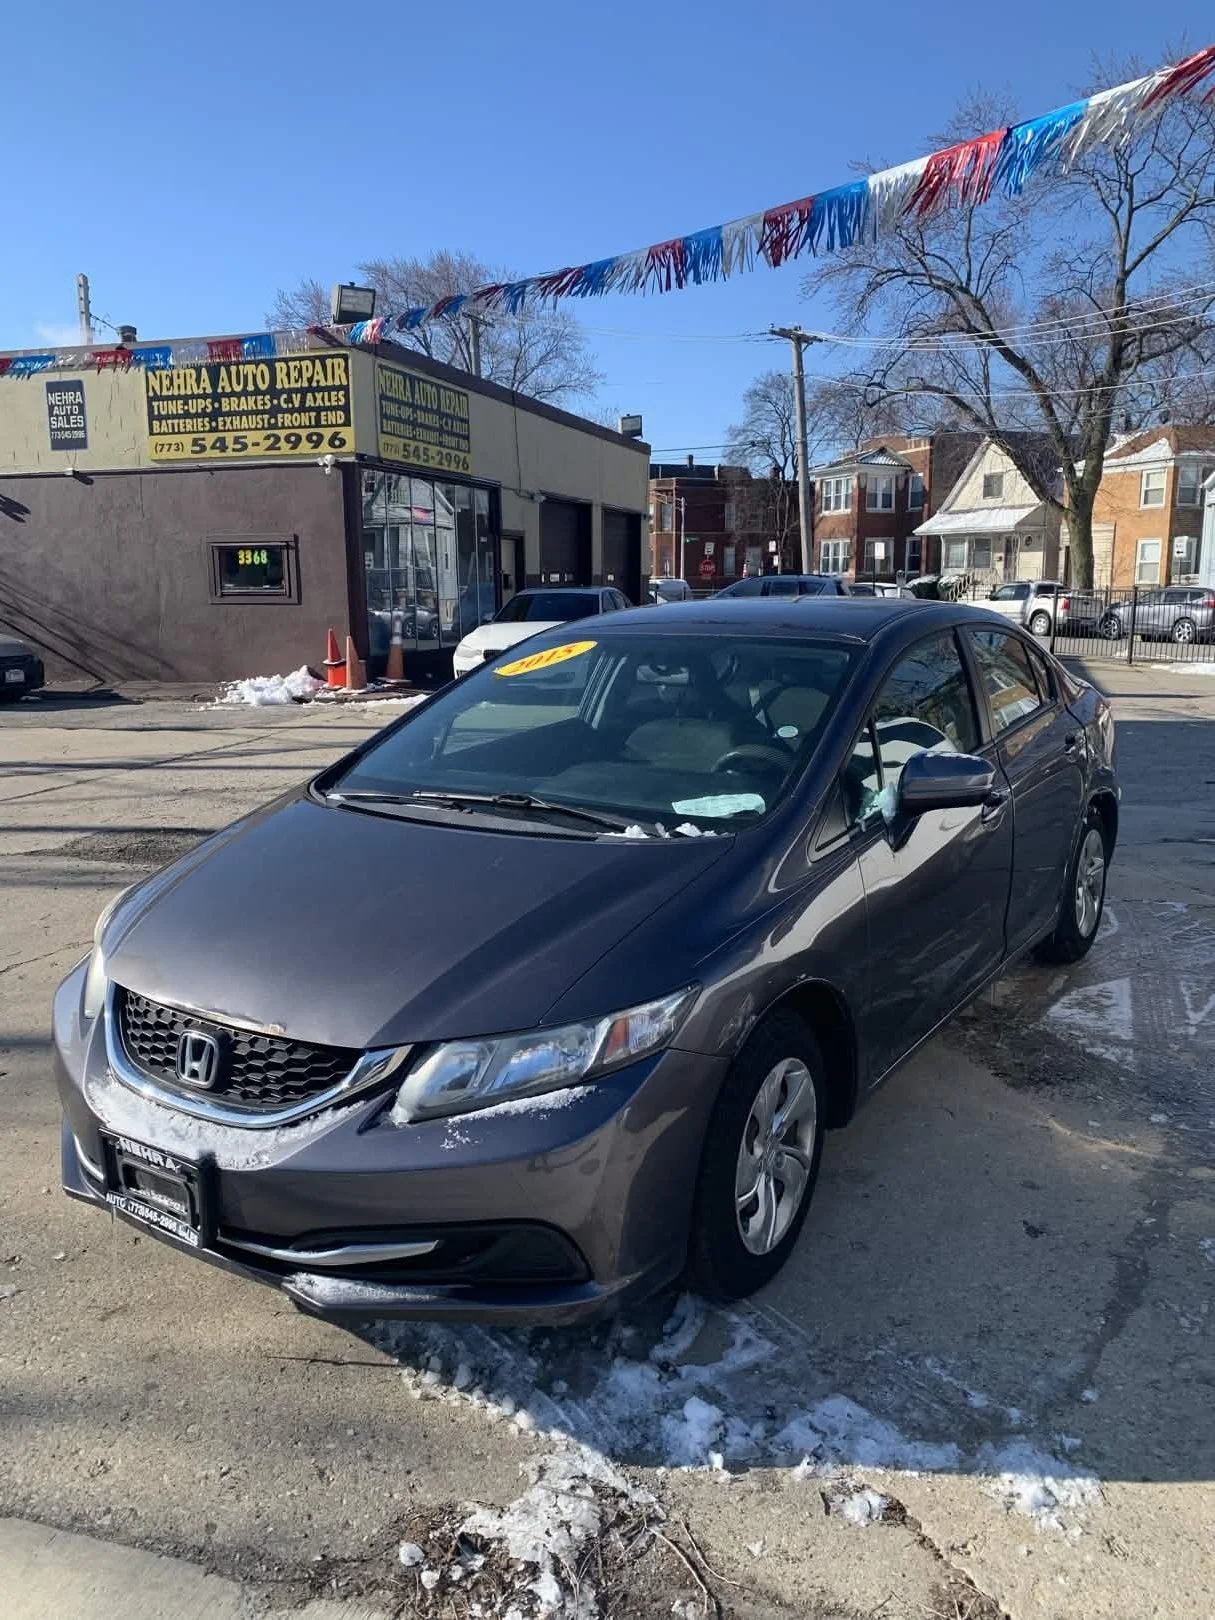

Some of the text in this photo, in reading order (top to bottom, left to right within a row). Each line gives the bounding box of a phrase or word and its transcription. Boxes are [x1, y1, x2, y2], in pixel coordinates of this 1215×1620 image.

[147, 358, 348, 397] NEHRA AUTO REPAIR
[48, 391, 83, 405] NEHRA
[152, 390, 345, 415] TUNE-UPS BRAKES C.V AXLES
[378, 367, 469, 418] NEHRA AUTO REPAIR
[50, 415, 84, 429] SALES
[52, 405, 79, 416] AUTO
[152, 410, 345, 434] BATTERIES EXHAUST FRONT END
[154, 431, 347, 455] (773) 545-2996
[402, 442, 470, 471] 545-2996
[238, 549, 268, 565] 3368
[105, 1192, 127, 1209] AUTO
